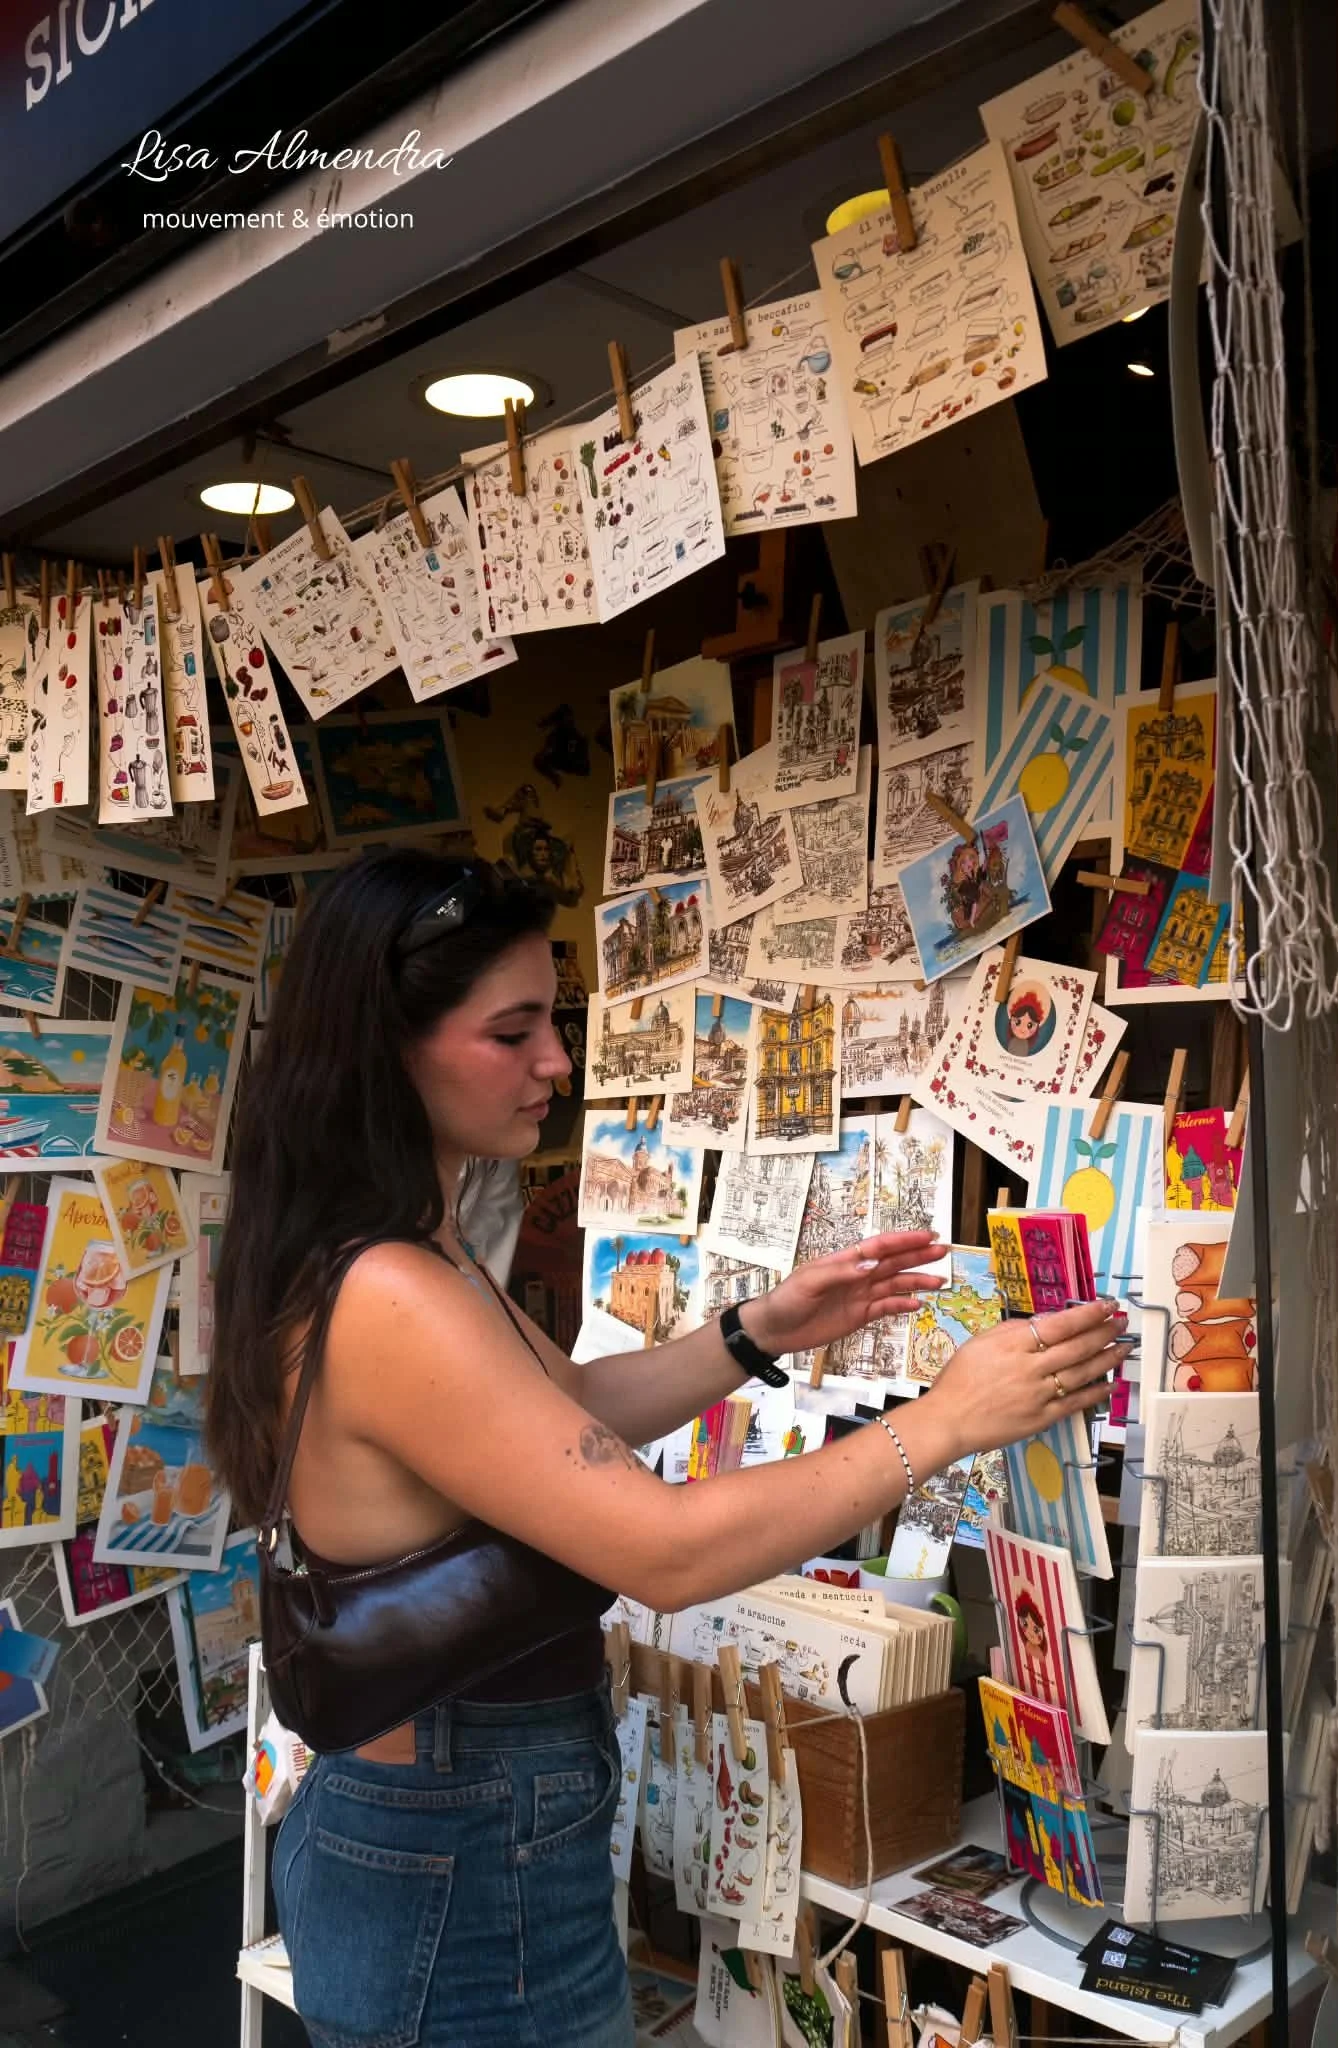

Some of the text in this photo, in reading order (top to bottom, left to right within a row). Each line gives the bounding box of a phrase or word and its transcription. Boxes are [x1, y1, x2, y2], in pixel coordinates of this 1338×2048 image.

[25, 0, 156, 112] SIC
[748, 1607, 786, 1628] arancine
[1096, 1978, 1150, 2000] Island
[1155, 1991, 1191, 2008] The
